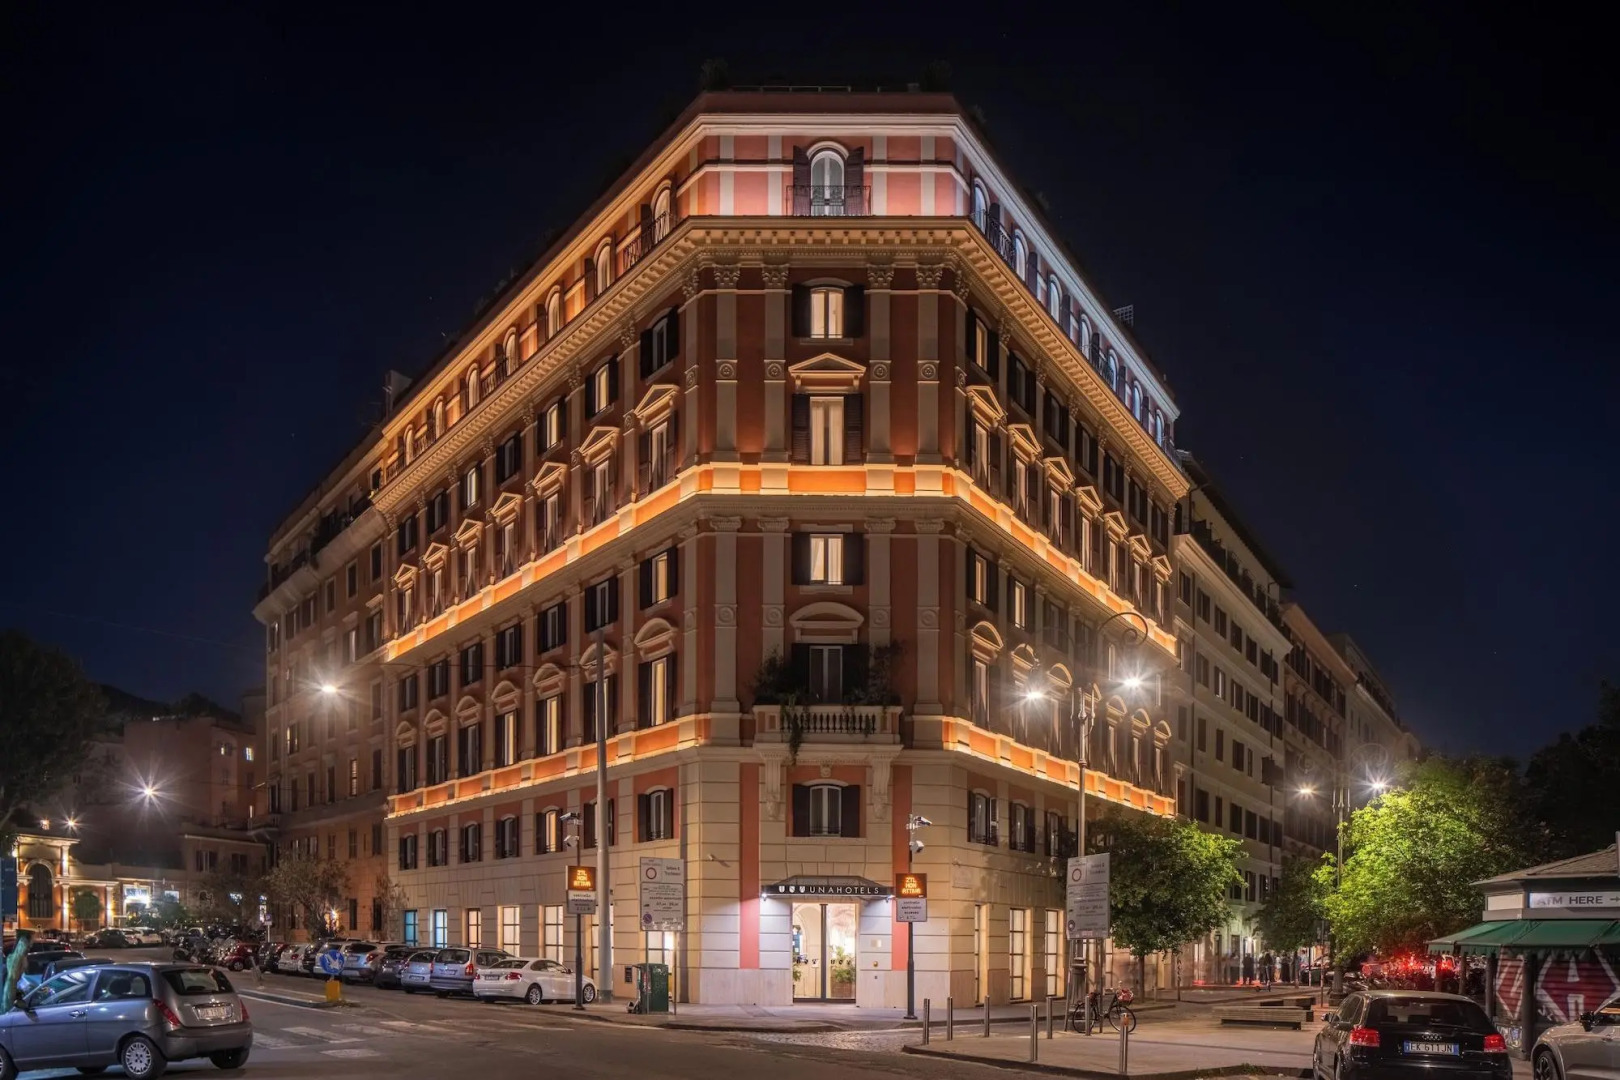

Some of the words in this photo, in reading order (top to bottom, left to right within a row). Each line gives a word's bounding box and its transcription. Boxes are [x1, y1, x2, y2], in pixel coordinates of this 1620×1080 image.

[809, 886, 879, 894] UNAHOTELS
[1537, 896, 1563, 905] ATM
[1569, 896, 1603, 905] HERE
